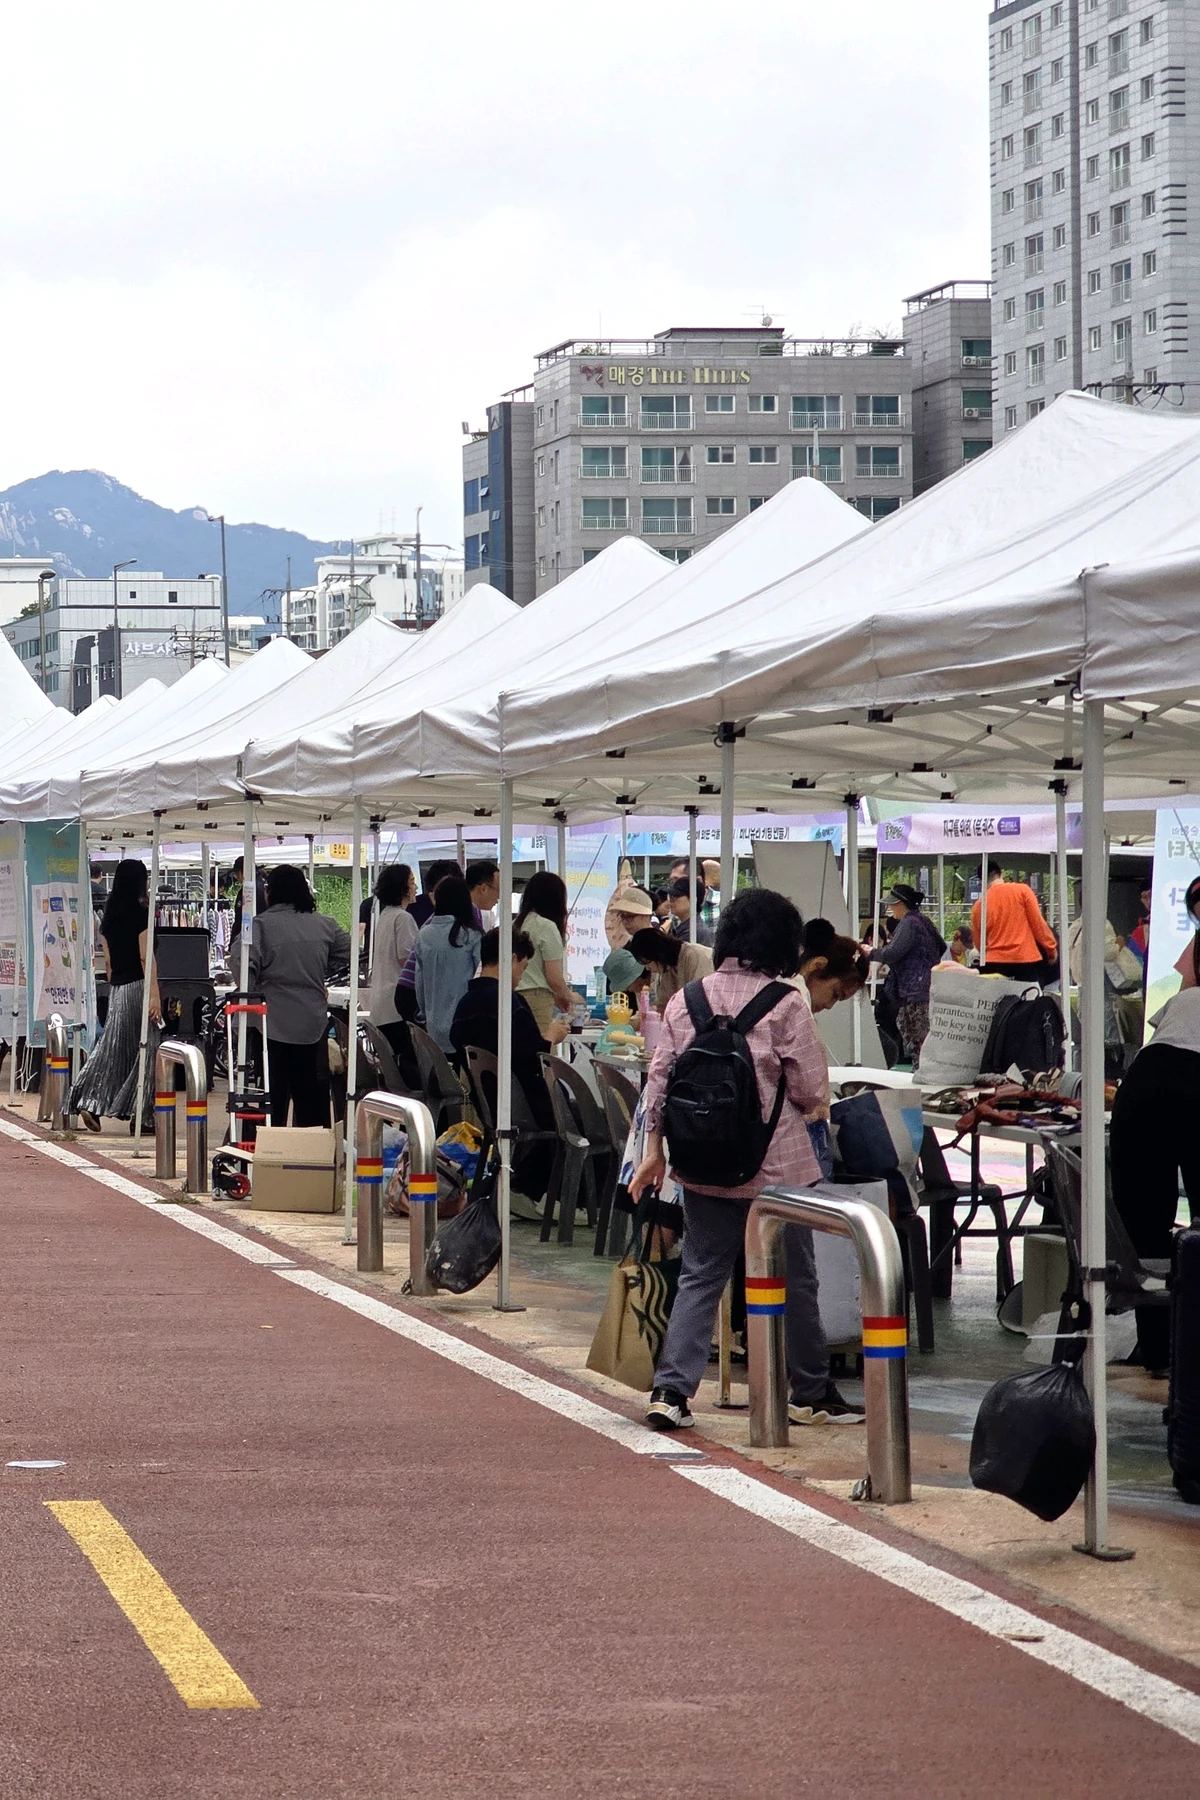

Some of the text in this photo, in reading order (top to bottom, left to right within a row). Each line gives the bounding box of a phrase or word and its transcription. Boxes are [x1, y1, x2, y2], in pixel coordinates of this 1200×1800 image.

[608, 365, 645, 386] 매경
[943, 819, 960, 838] 지구를
[960, 819, 971, 837] 위한
[934, 1016, 948, 1027] The
[949, 1018, 966, 1031] key
[967, 1022, 977, 1031] to
[947, 1032, 966, 1042] time
[966, 1035, 984, 1045] you
